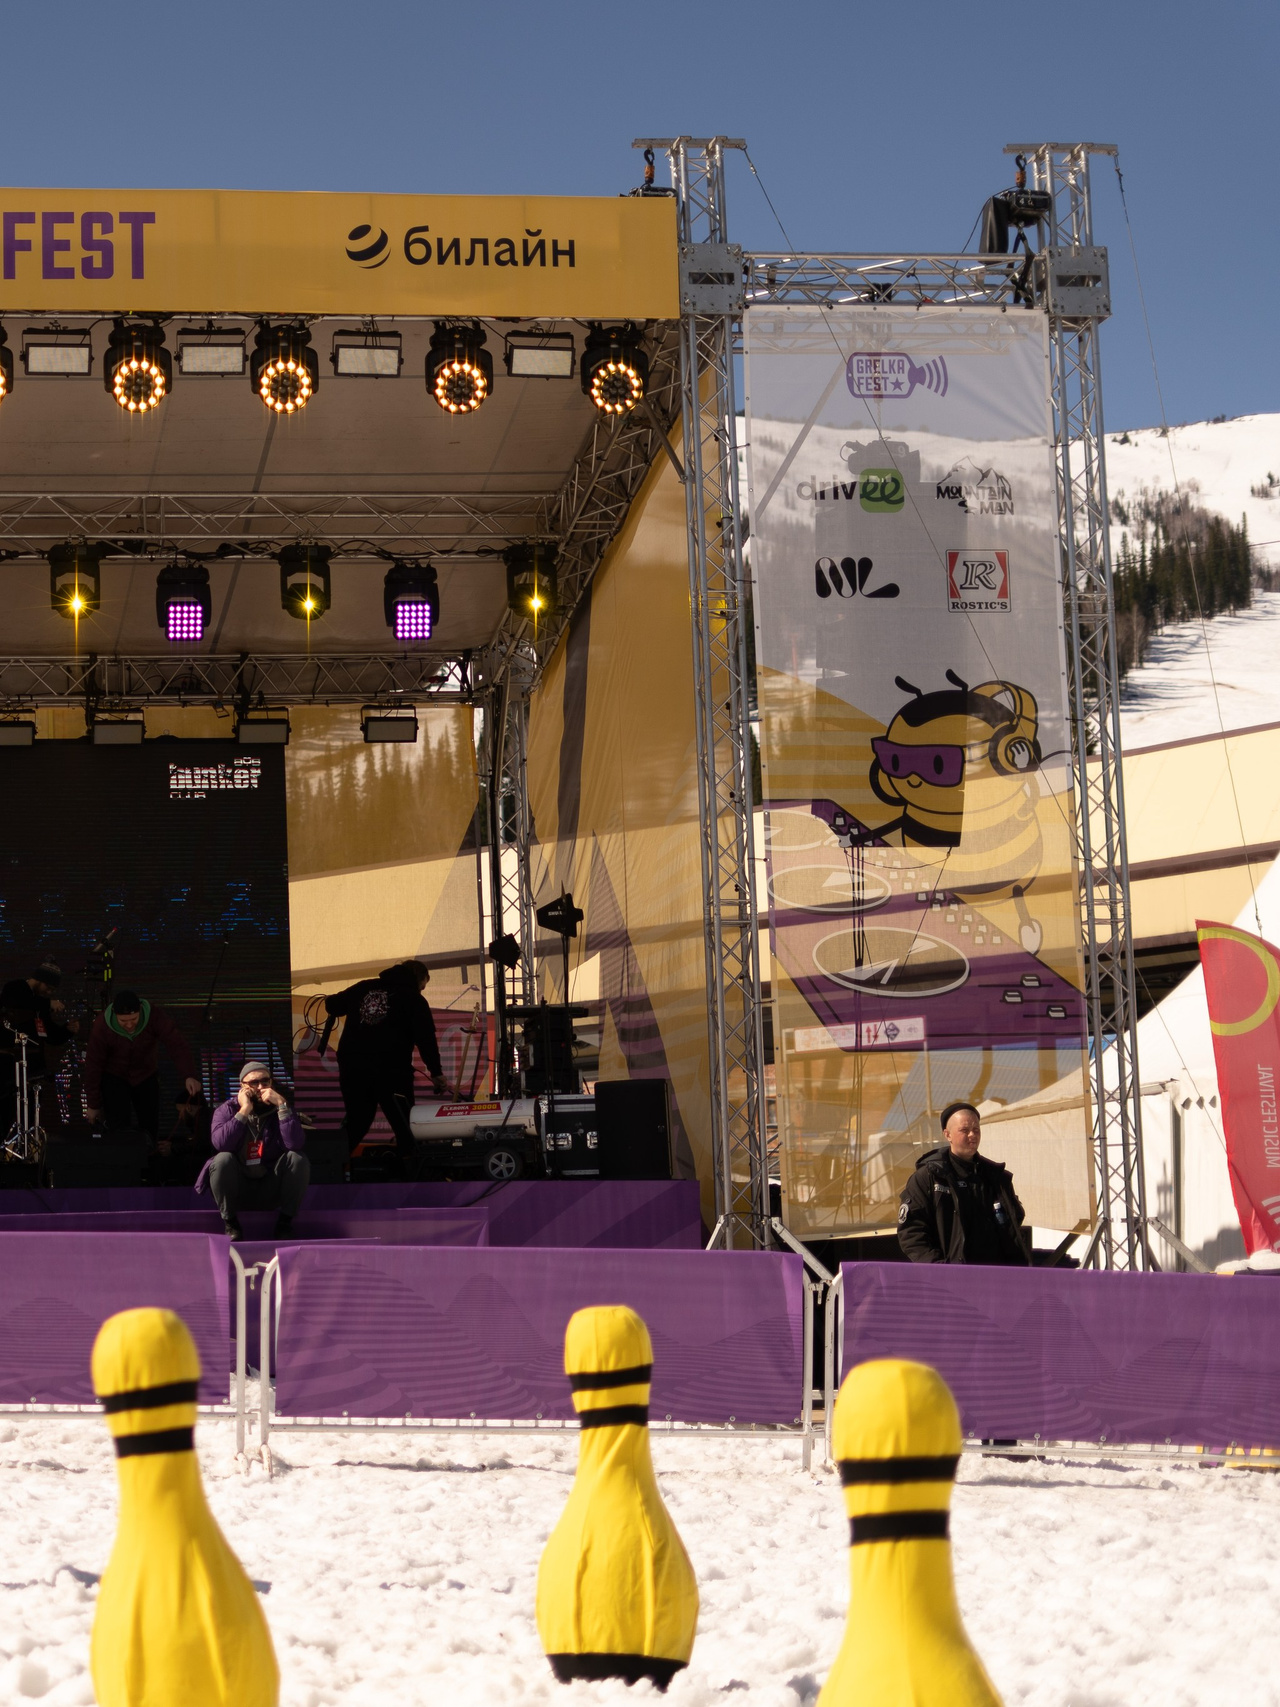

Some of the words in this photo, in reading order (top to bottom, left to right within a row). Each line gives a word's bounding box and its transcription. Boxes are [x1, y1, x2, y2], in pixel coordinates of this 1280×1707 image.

[403, 225, 577, 268] билайн
[856, 358, 905, 374] GRELKA
[857, 377, 889, 391] FEST
[796, 475, 905, 505] drivee
[936, 485, 1012, 501] MOUNTAIN
[979, 501, 1014, 515] MAN
[959, 560, 997, 590] R
[951, 601, 1008, 610] ROSTIC'S
